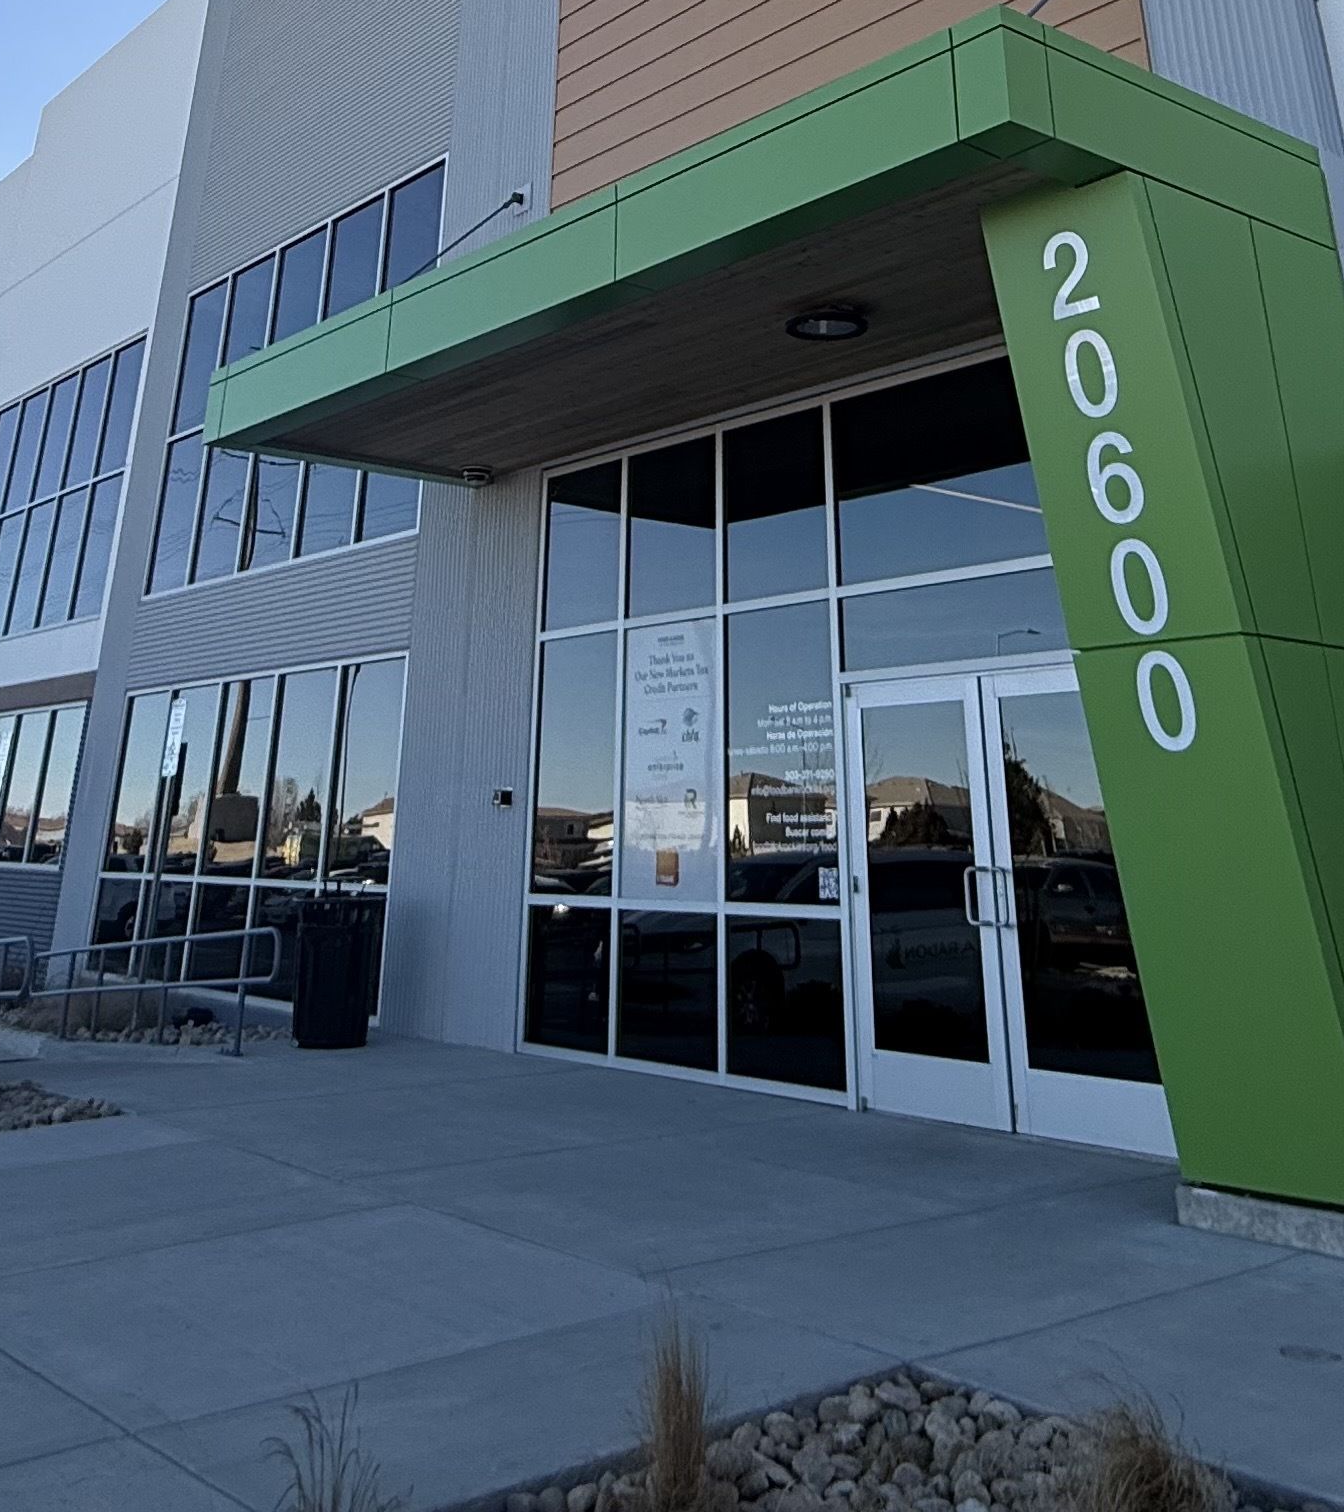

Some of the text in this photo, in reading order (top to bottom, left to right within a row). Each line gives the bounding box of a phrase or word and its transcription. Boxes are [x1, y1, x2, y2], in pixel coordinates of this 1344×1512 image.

[1043, 231, 1197, 753] 20600
[768, 700, 832, 714] Hours of Operation
[766, 730, 786, 741] Horas
[786, 730, 796, 740] de
